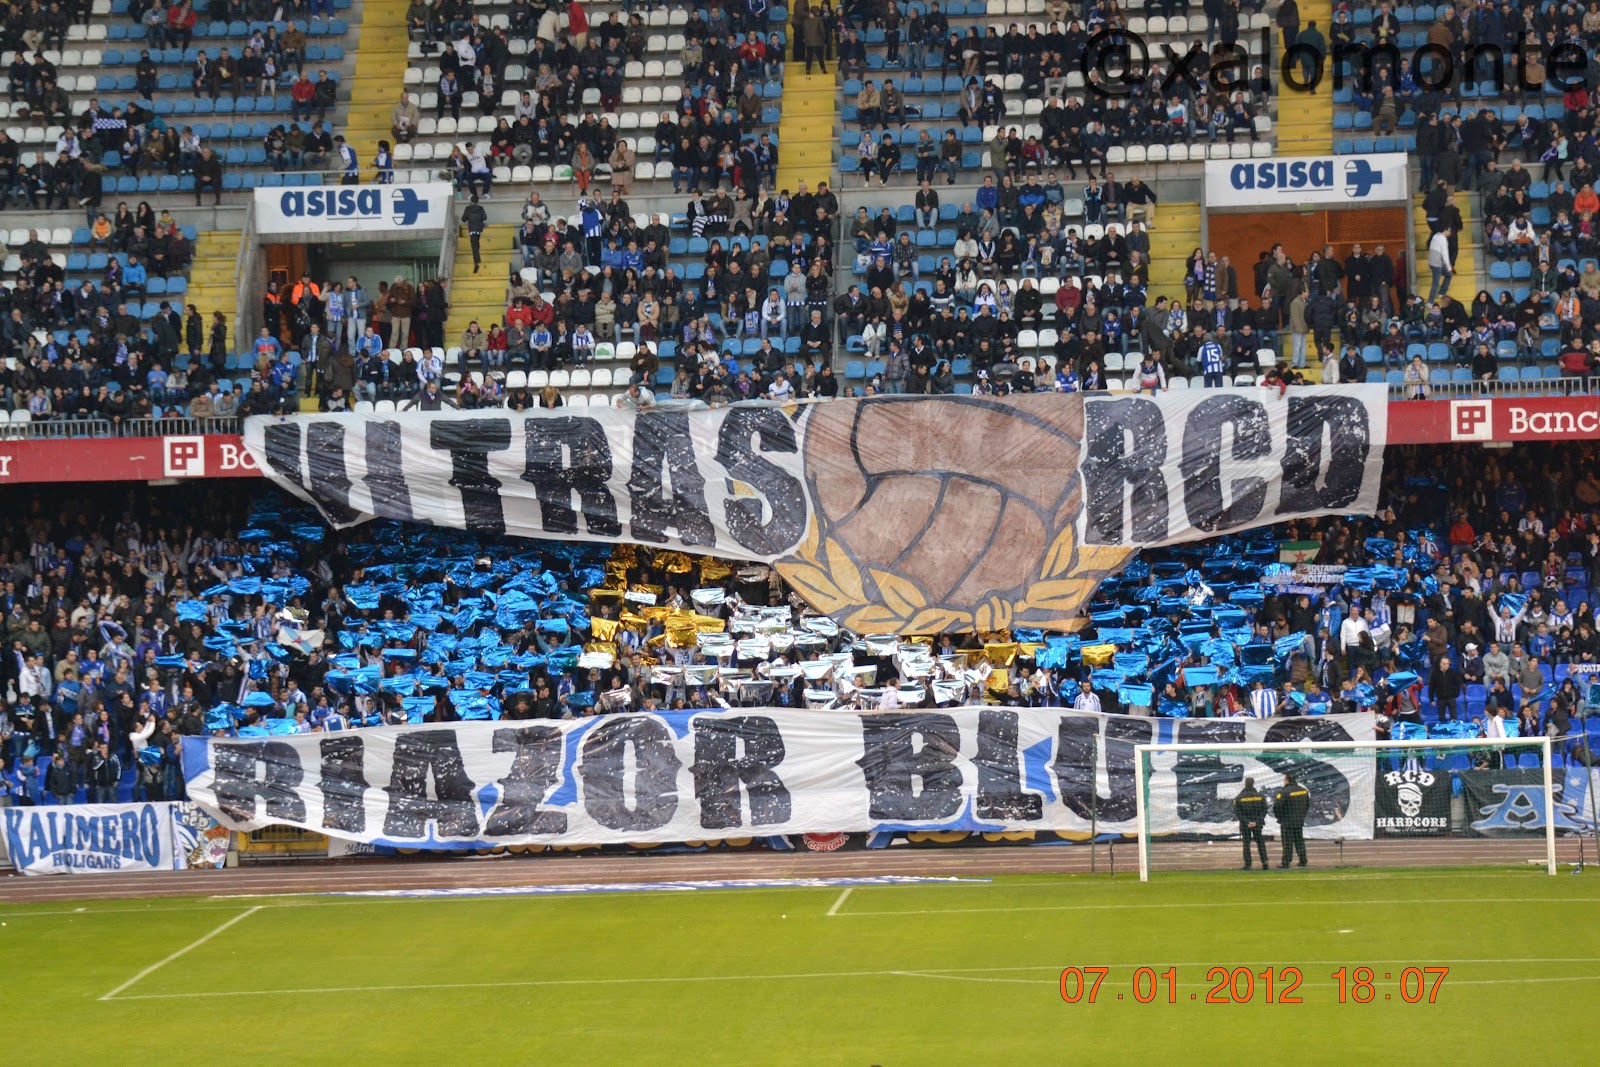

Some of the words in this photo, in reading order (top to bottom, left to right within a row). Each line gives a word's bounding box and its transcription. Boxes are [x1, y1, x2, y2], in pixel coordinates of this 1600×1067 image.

[1230, 160, 1334, 190] asisa
[280, 188, 382, 217] asisa
[1206, 348, 1220, 362] 15
[1508, 407, 1600, 434] Banc
[1081, 394, 1371, 546] RCD
[208, 715, 792, 839] RIAZOR
[854, 709, 1356, 827] BLUES
[1383, 769, 1435, 787] RCD
[4, 803, 160, 869] KALIMERO
[1376, 817, 1447, 828] HARDCORE
